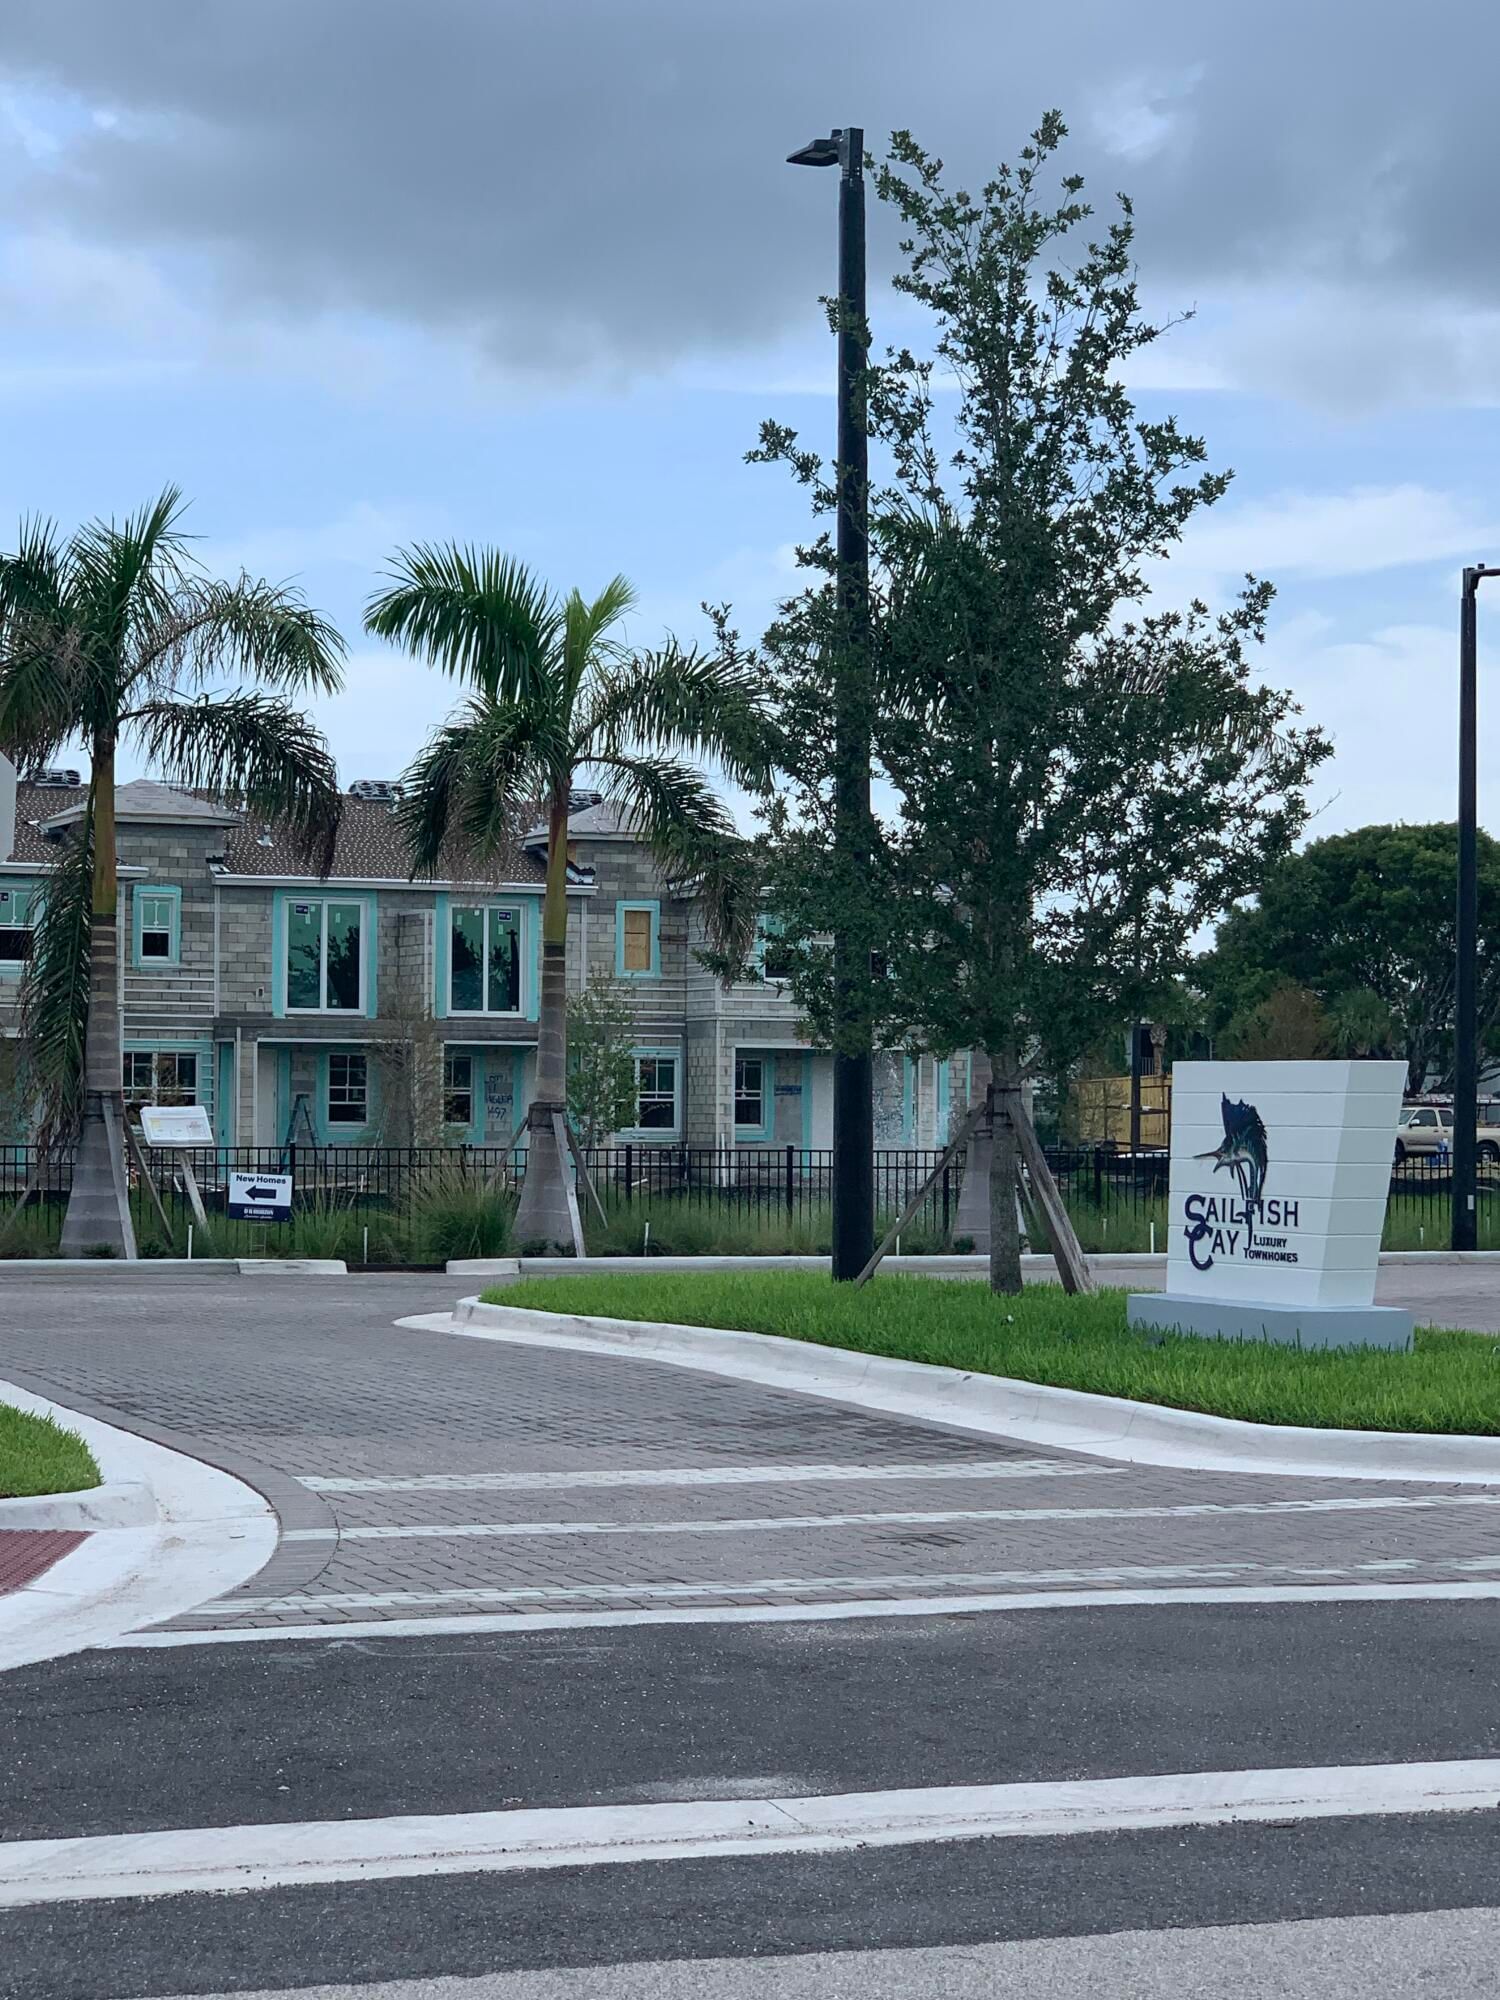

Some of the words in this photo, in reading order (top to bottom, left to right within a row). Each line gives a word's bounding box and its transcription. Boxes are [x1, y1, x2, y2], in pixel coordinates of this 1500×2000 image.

[236, 1174, 255, 1182] New
[257, 1175, 286, 1184] Homes
[1184, 1194, 1299, 1238] SAILFISH
[1189, 1223, 1239, 1270] CAY
[1254, 1234, 1287, 1248] LUXURY
[1243, 1247, 1298, 1262] TOWNHOMES
